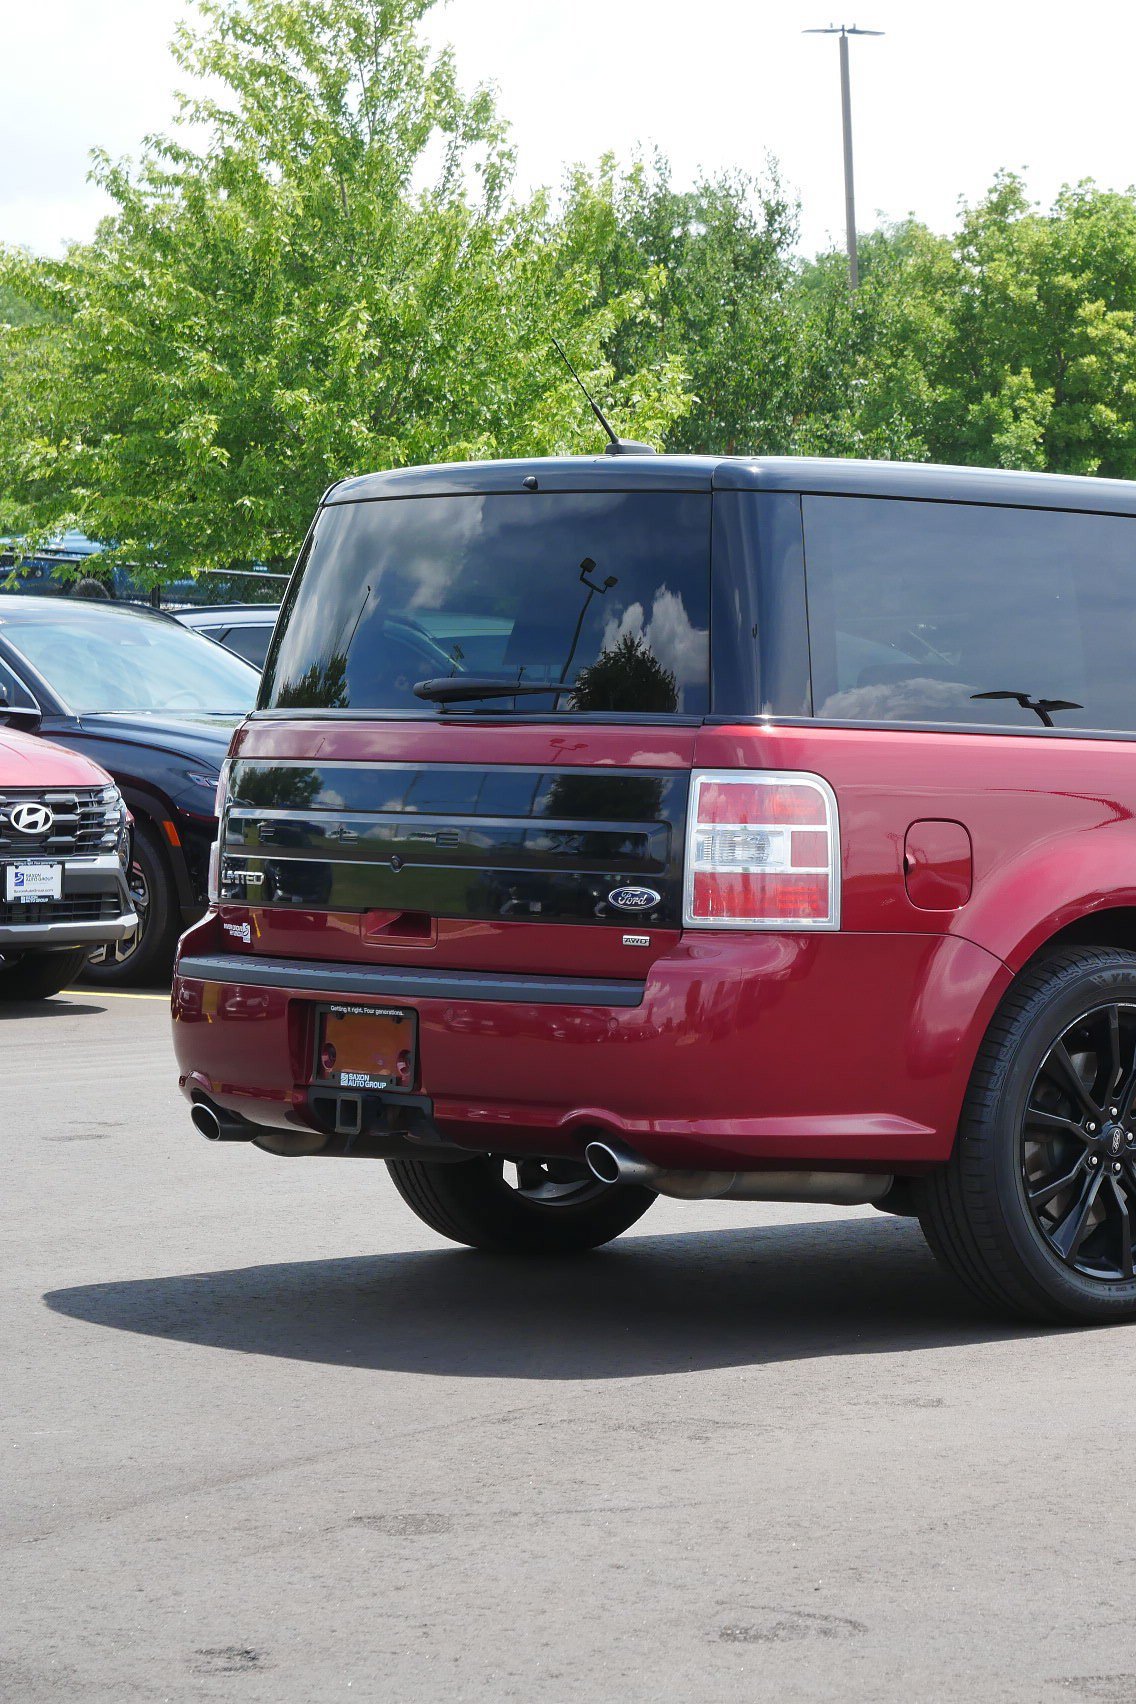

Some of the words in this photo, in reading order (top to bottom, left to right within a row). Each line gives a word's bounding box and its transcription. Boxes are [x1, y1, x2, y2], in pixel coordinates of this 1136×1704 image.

[348, 1073, 370, 1081] SAXON
[348, 1080, 365, 1088] AUTO
[365, 1081, 387, 1089] GROUP
